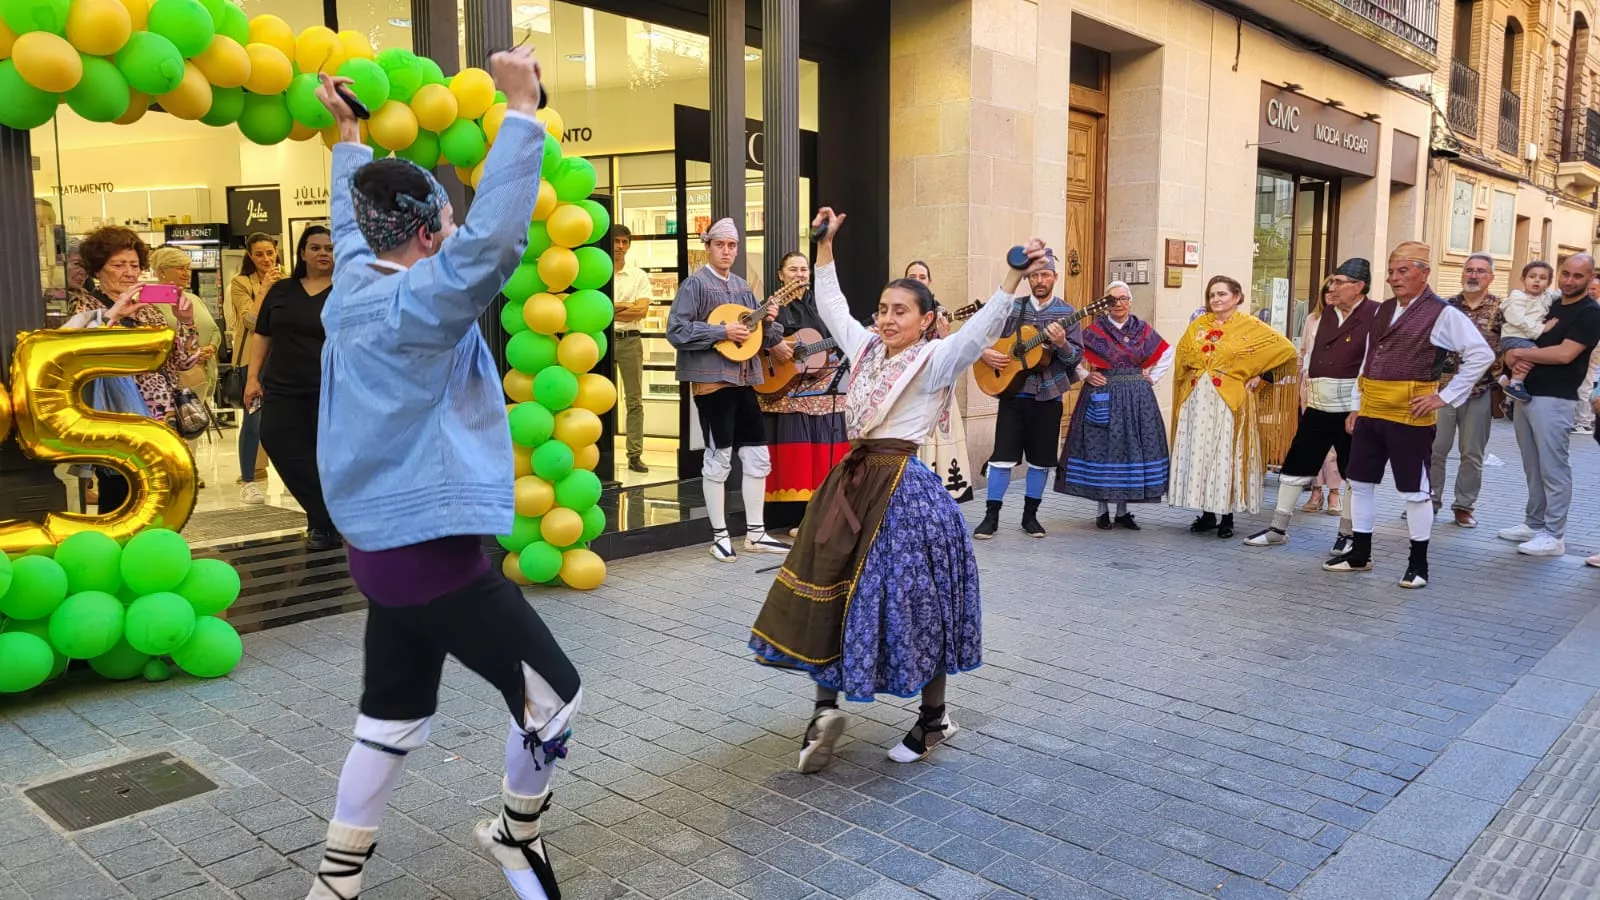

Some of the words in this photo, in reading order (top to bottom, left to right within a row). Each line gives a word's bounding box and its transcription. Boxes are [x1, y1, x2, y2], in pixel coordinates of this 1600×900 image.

[1267, 98, 1300, 133] CMC
[1315, 123, 1340, 146] MODA
[1343, 132, 1368, 153] HOGAR
[191, 228, 212, 237] BONET
